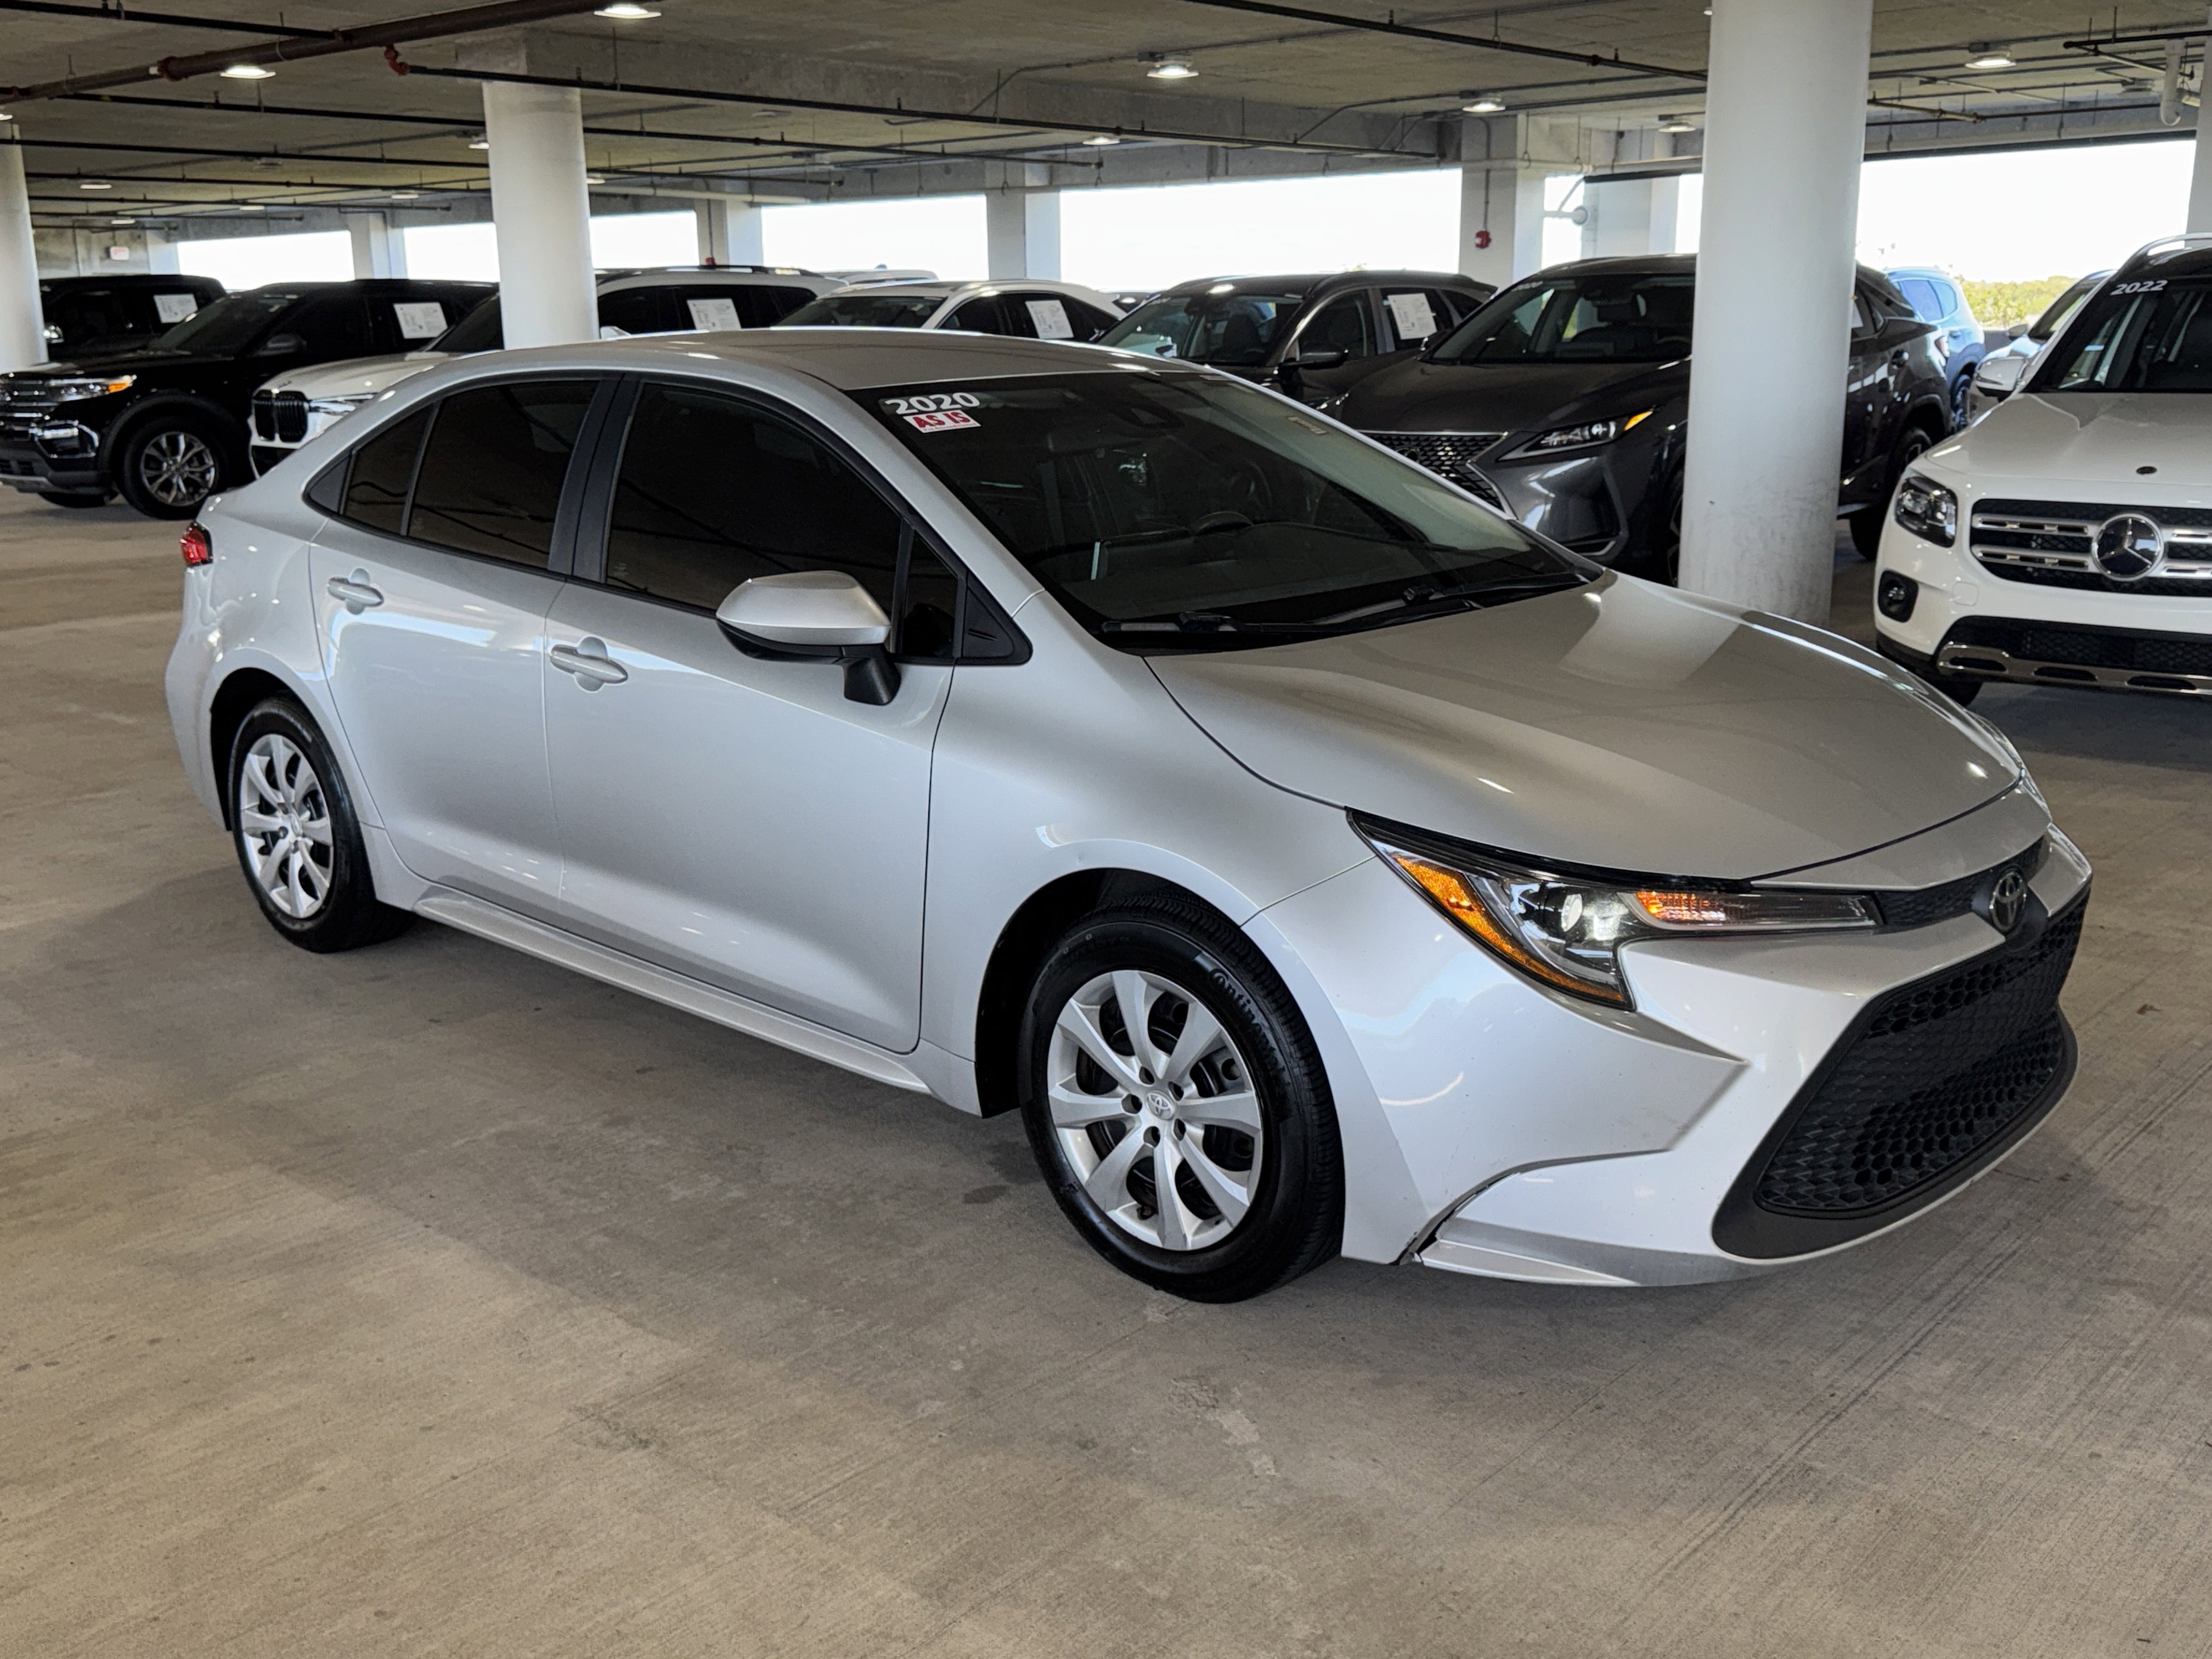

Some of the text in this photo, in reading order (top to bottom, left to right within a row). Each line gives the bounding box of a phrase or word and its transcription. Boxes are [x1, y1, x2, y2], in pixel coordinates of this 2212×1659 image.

[2109, 279, 2168, 296] 2022
[884, 392, 980, 415] 2020
[912, 415, 945, 428] AS
[942, 412, 970, 424] IS
[1209, 968, 1286, 1079] Continental
